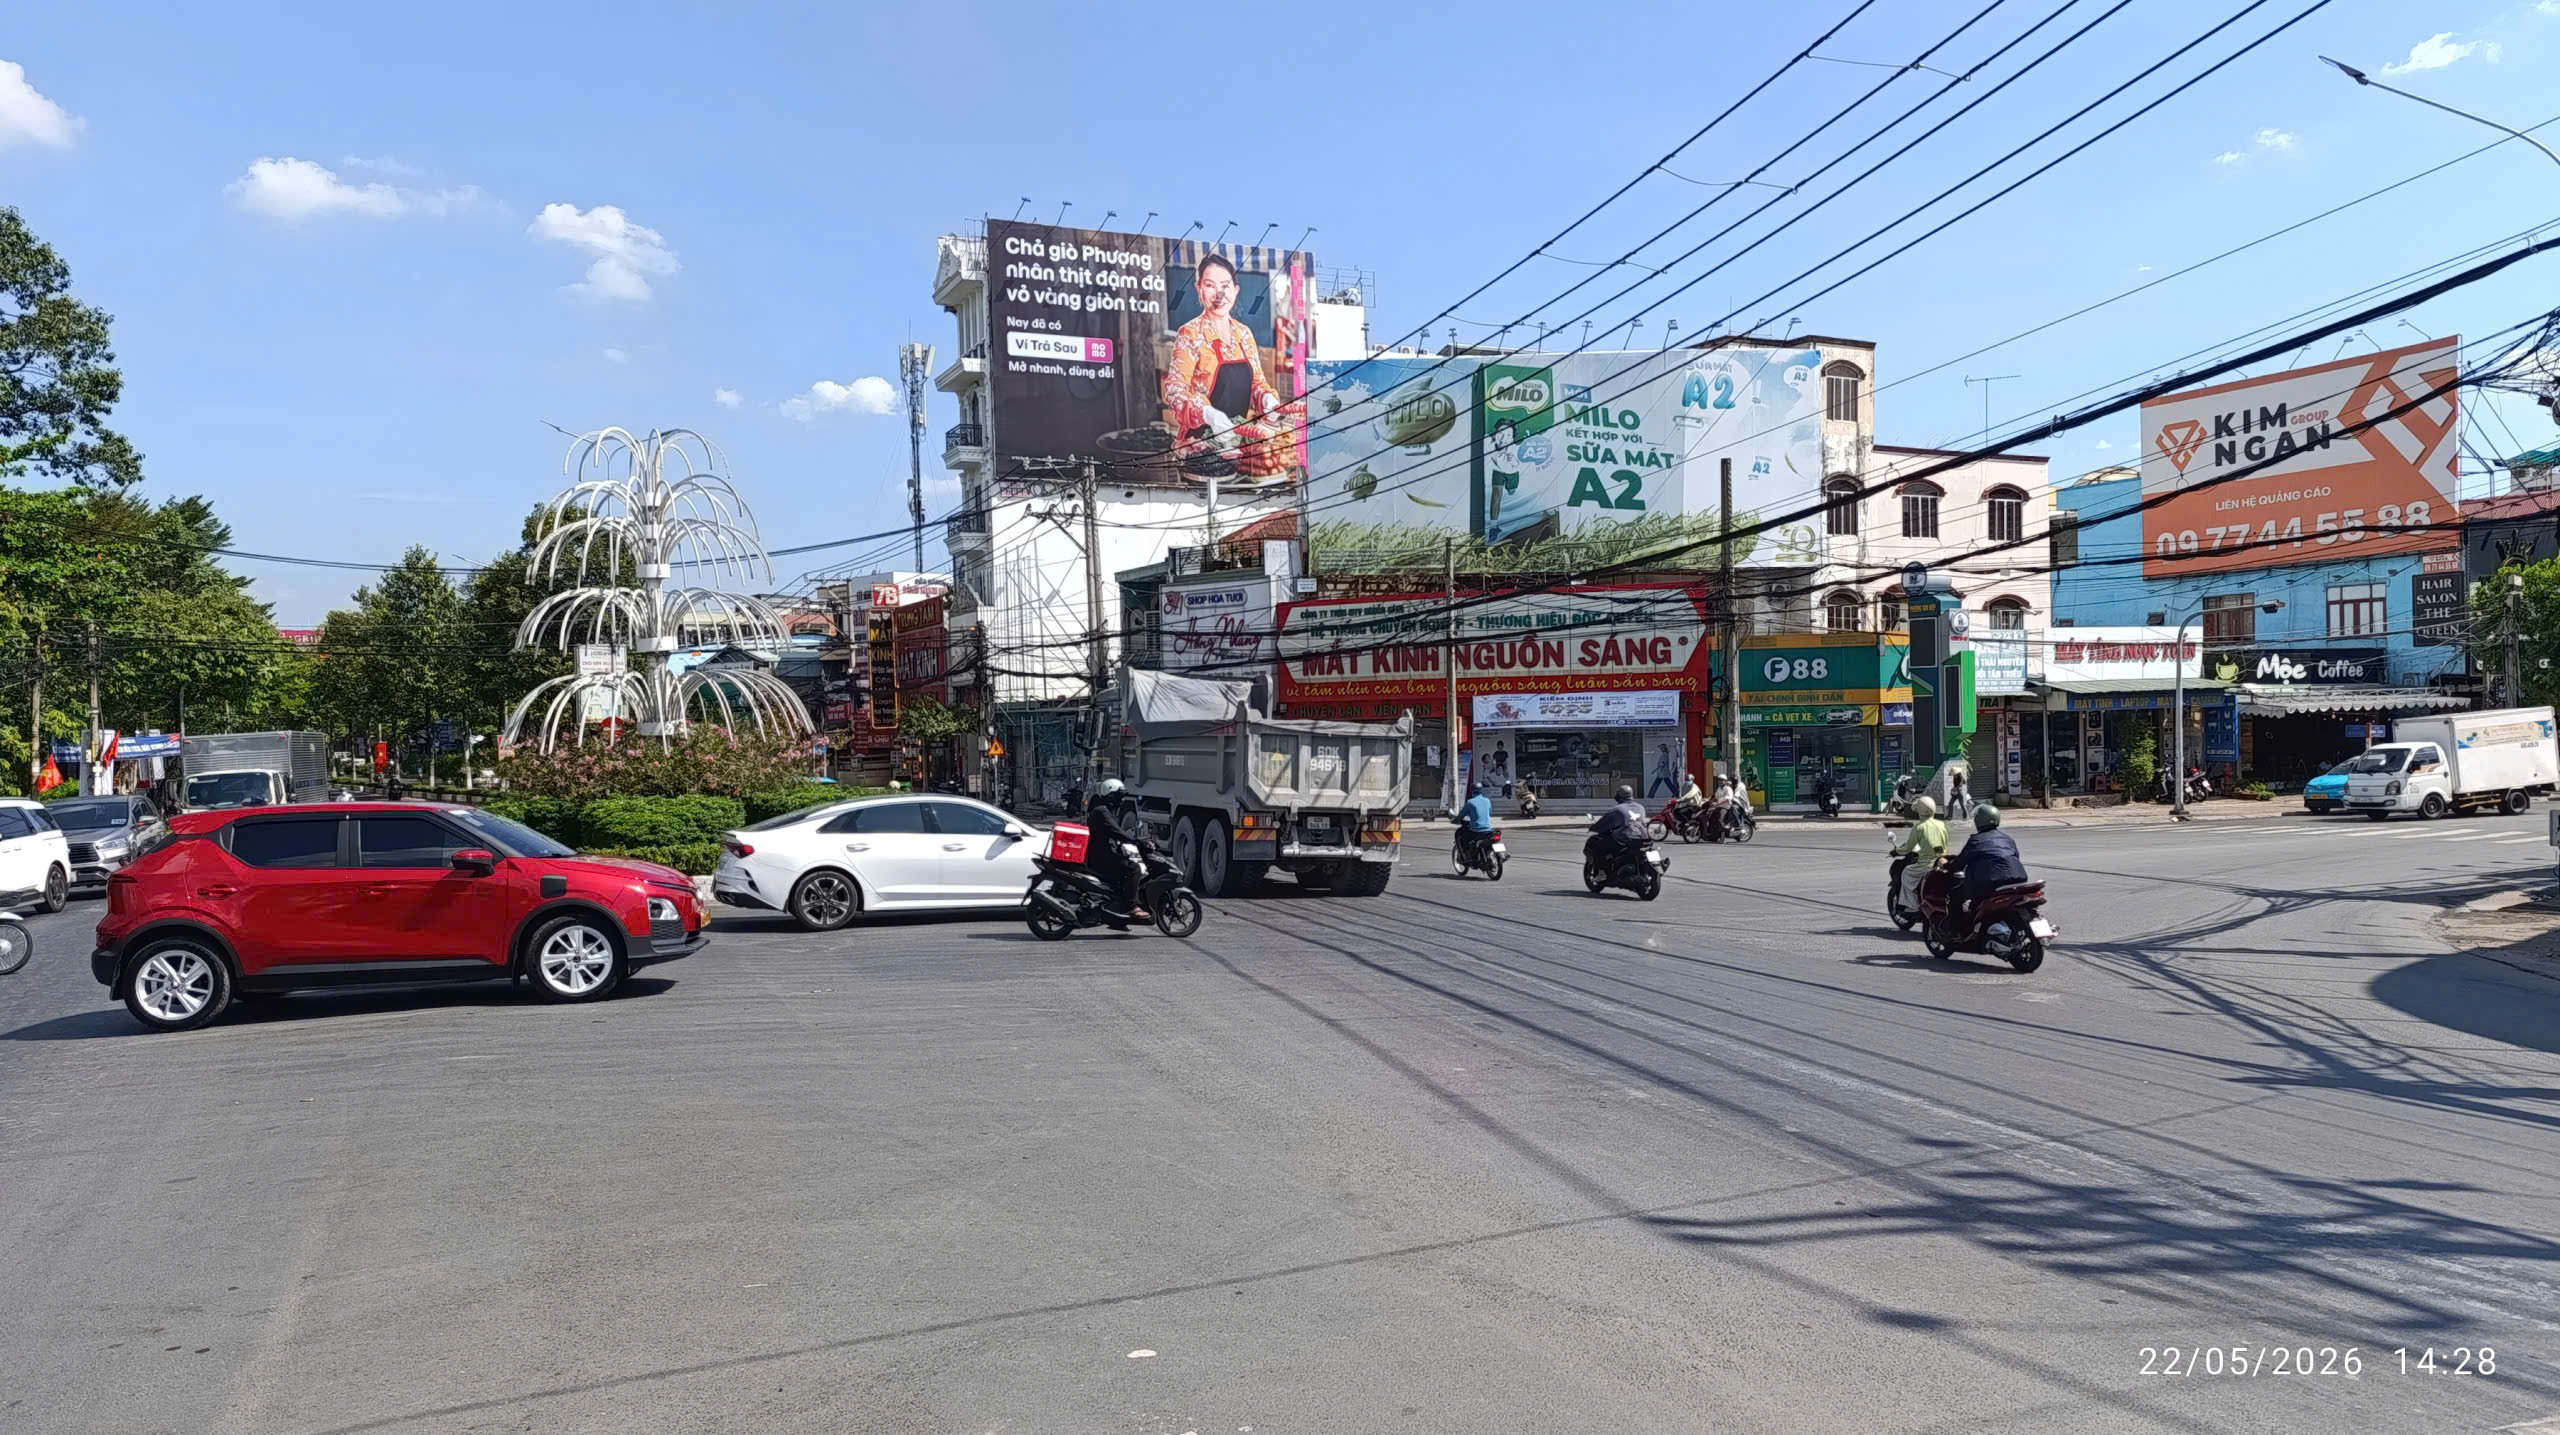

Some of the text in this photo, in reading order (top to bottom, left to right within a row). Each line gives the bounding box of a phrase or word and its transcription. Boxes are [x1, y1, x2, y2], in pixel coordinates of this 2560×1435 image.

[1005, 236, 1151, 270] Chả giò Phượng
[1006, 262, 1164, 293] nhân thịt đậm đà
[1006, 284, 1159, 313] vỏ vàng giòn tan
[1007, 316, 1062, 331] Nay đã có
[1016, 338, 1078, 354] Ví Trả Sau
[1008, 360, 1115, 378] Mở nhanh, dùng dễ!
[1794, 372, 1808, 382] A2
[1497, 386, 1543, 402] MILO
[1682, 371, 1736, 409] A2
[1564, 404, 1640, 430] MILO
[2214, 403, 2329, 440] KIM GROUP
[1566, 427, 1642, 443] KẾT HỢP VỚI
[1522, 446, 1548, 458] A2
[1567, 441, 1674, 469] SỮA MÁT
[1752, 462, 1770, 474] A2
[1567, 468, 1646, 510] A2
[2216, 496, 2239, 511] LIÊN
[2242, 493, 2256, 510] HỆ
[2259, 488, 2300, 506] QUẢNG
[2376, 500, 2432, 538] 88
[2422, 578, 2452, 590] HAIR
[874, 587, 898, 605] 7B
[1188, 596, 1207, 605] SHOP
[1208, 594, 1224, 604] HOA
[2416, 592, 2458, 604] SALON
[2424, 607, 2452, 618] THE
[1455, 630, 1564, 670] NGUỒN
[1578, 631, 1672, 668] SÁNG
[1765, 657, 1828, 682] F88
[2257, 654, 2364, 686] Mộc Coffee
[1374, 680, 1402, 694] của
[1407, 680, 1437, 696] bạn
[1518, 675, 1562, 694] sáng
[1772, 711, 1784, 722] CÀ
[1786, 712, 1800, 724] VẸT
[1802, 712, 1812, 721] XE
[1318, 746, 1340, 758] 60K
